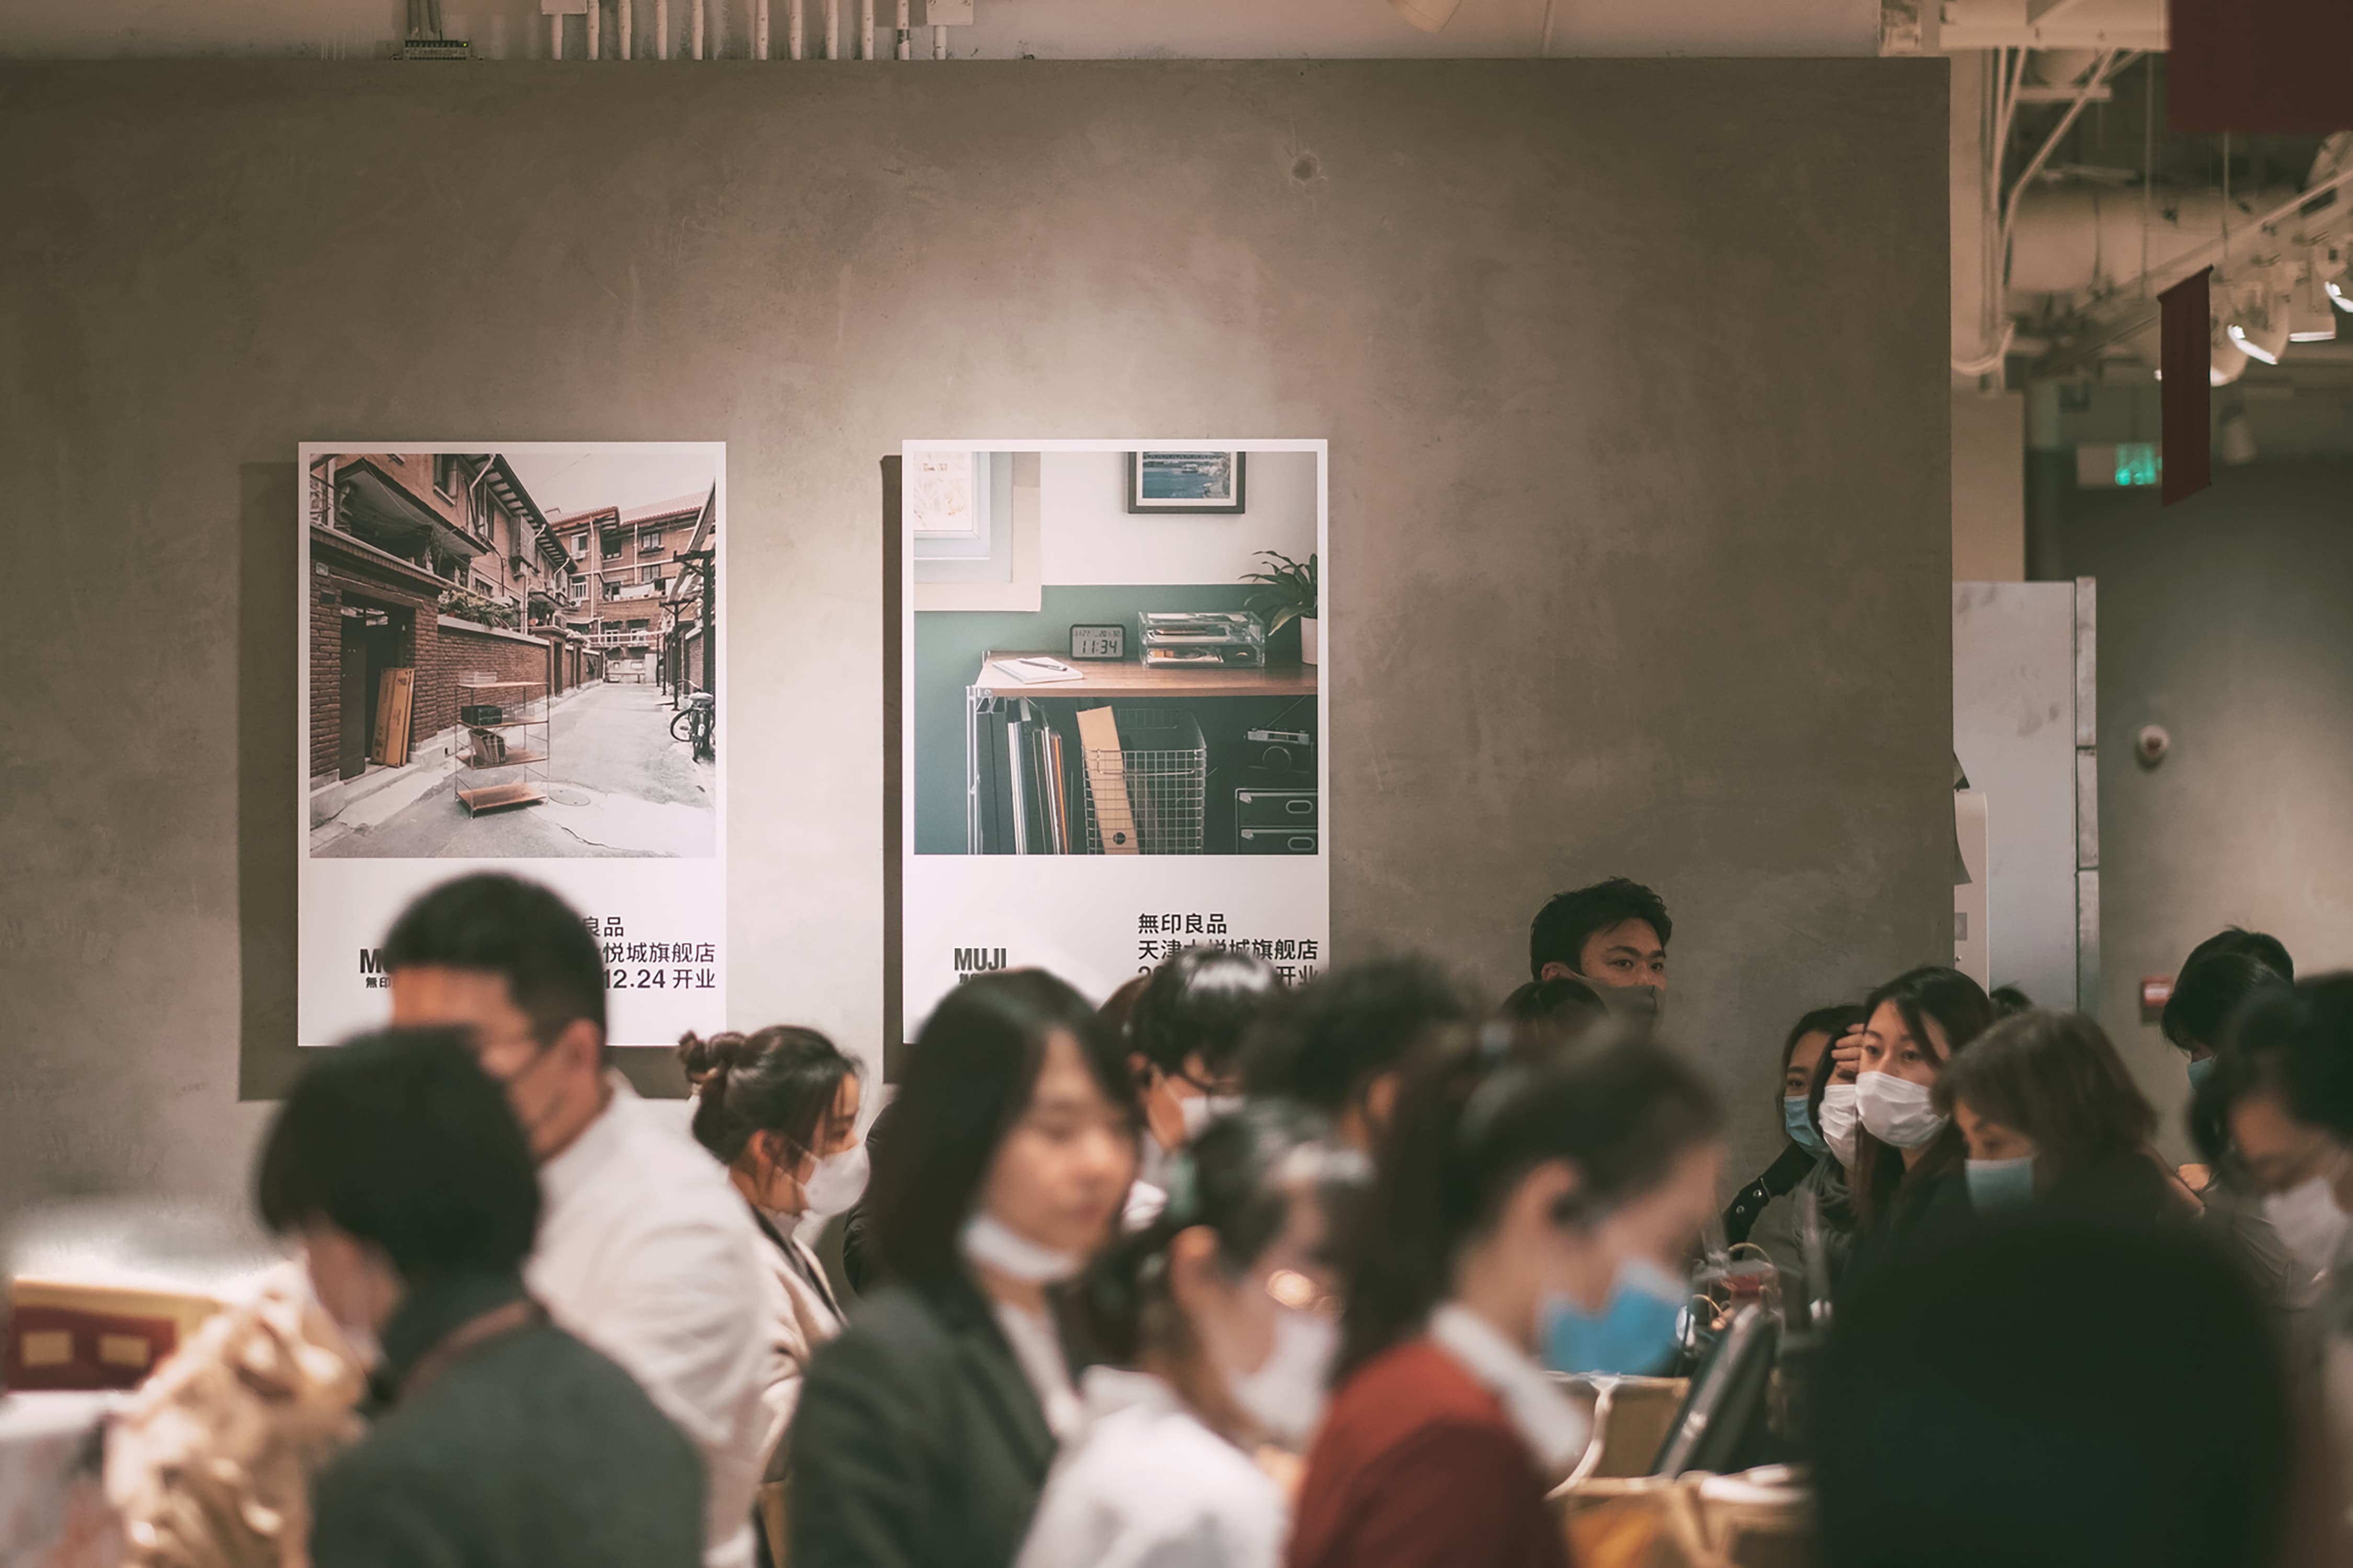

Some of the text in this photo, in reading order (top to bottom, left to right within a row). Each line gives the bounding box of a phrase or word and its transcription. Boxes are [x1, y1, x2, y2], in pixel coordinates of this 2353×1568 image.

[1082, 639, 1117, 654] 11:34
[583, 916, 624, 937] 良品
[1138, 913, 1227, 934] 無印良品
[360, 948, 384, 973] M
[603, 942, 716, 963] 悦城旗舰店
[954, 947, 1007, 971] MUJI
[366, 976, 391, 989] 無印
[604, 967, 716, 989] 12.24 开业
